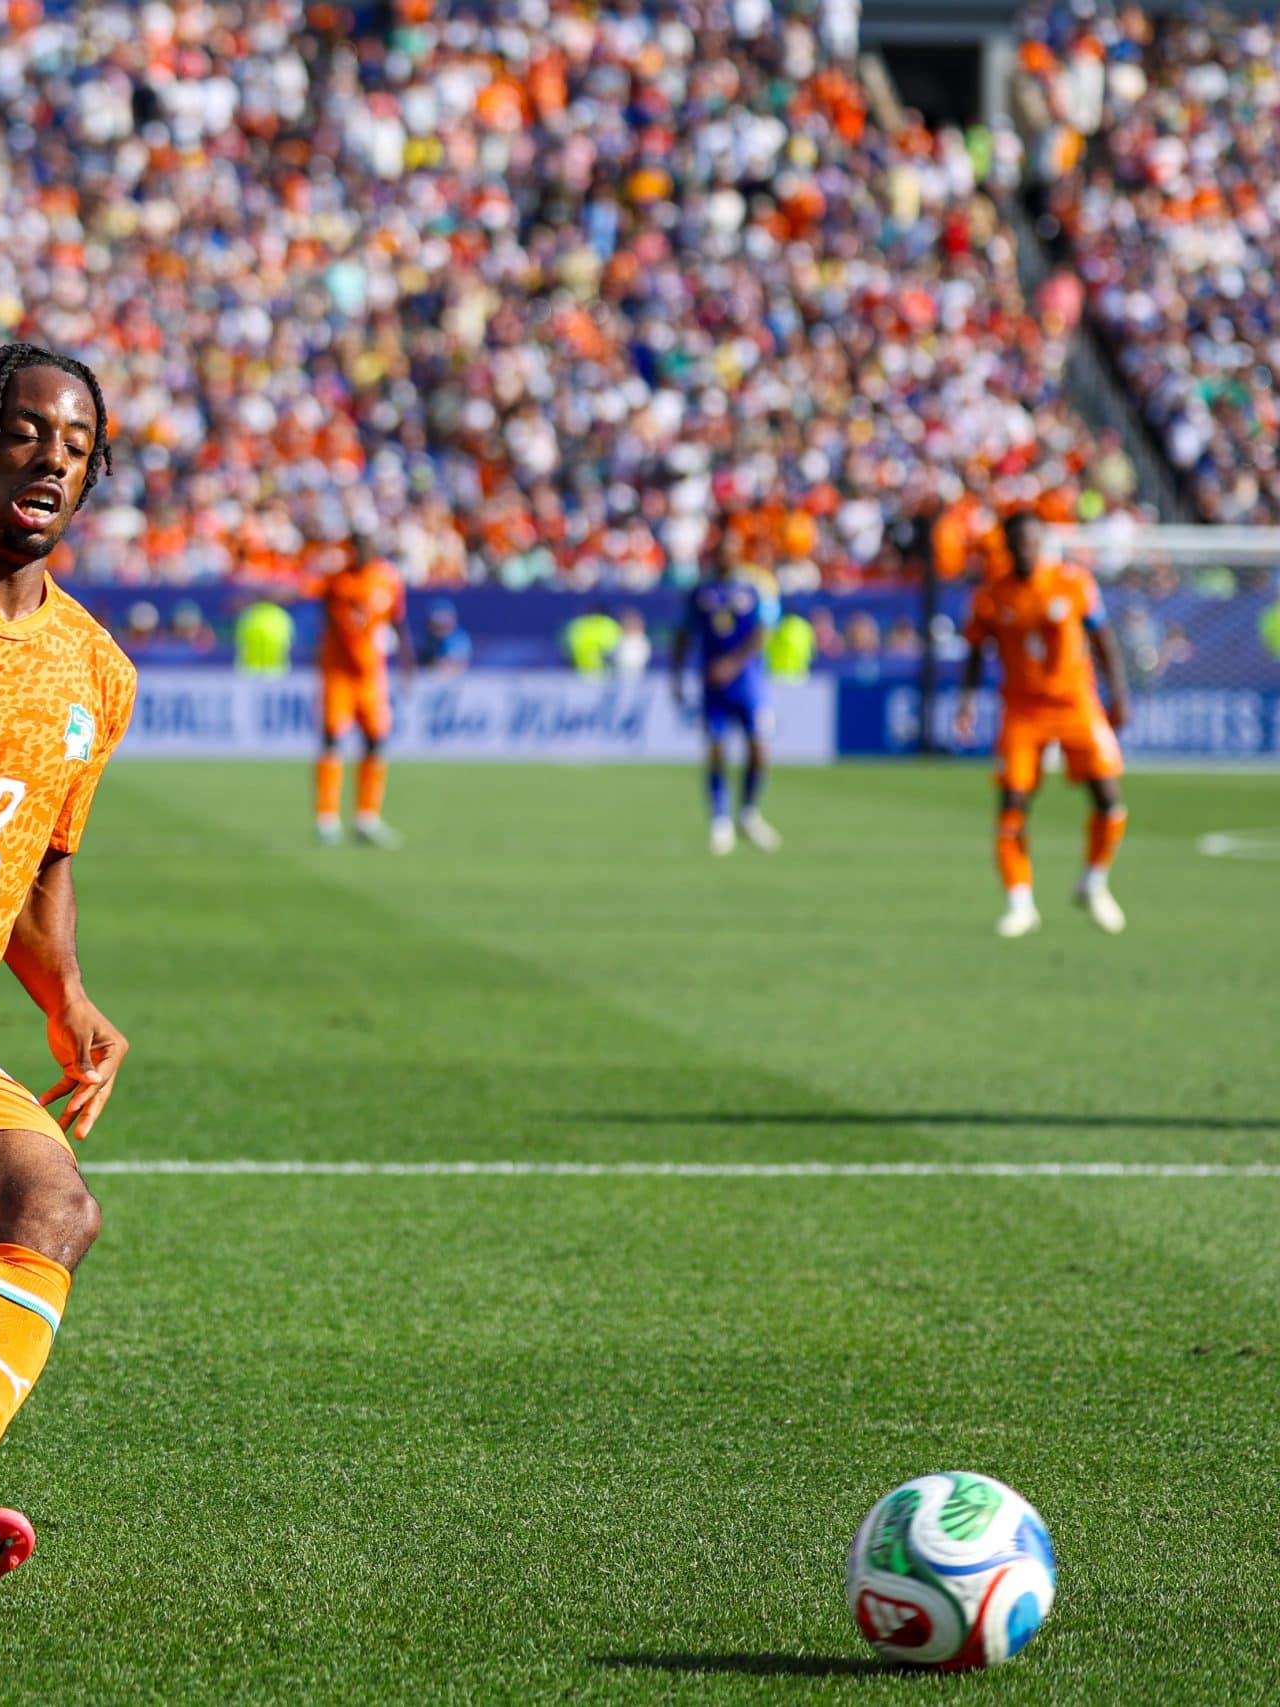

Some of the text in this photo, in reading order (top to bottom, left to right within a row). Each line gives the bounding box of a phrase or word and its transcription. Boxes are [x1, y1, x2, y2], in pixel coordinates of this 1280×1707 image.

[136, 688, 236, 738] BALL
[422, 684, 490, 738] the
[505, 680, 652, 744] World
